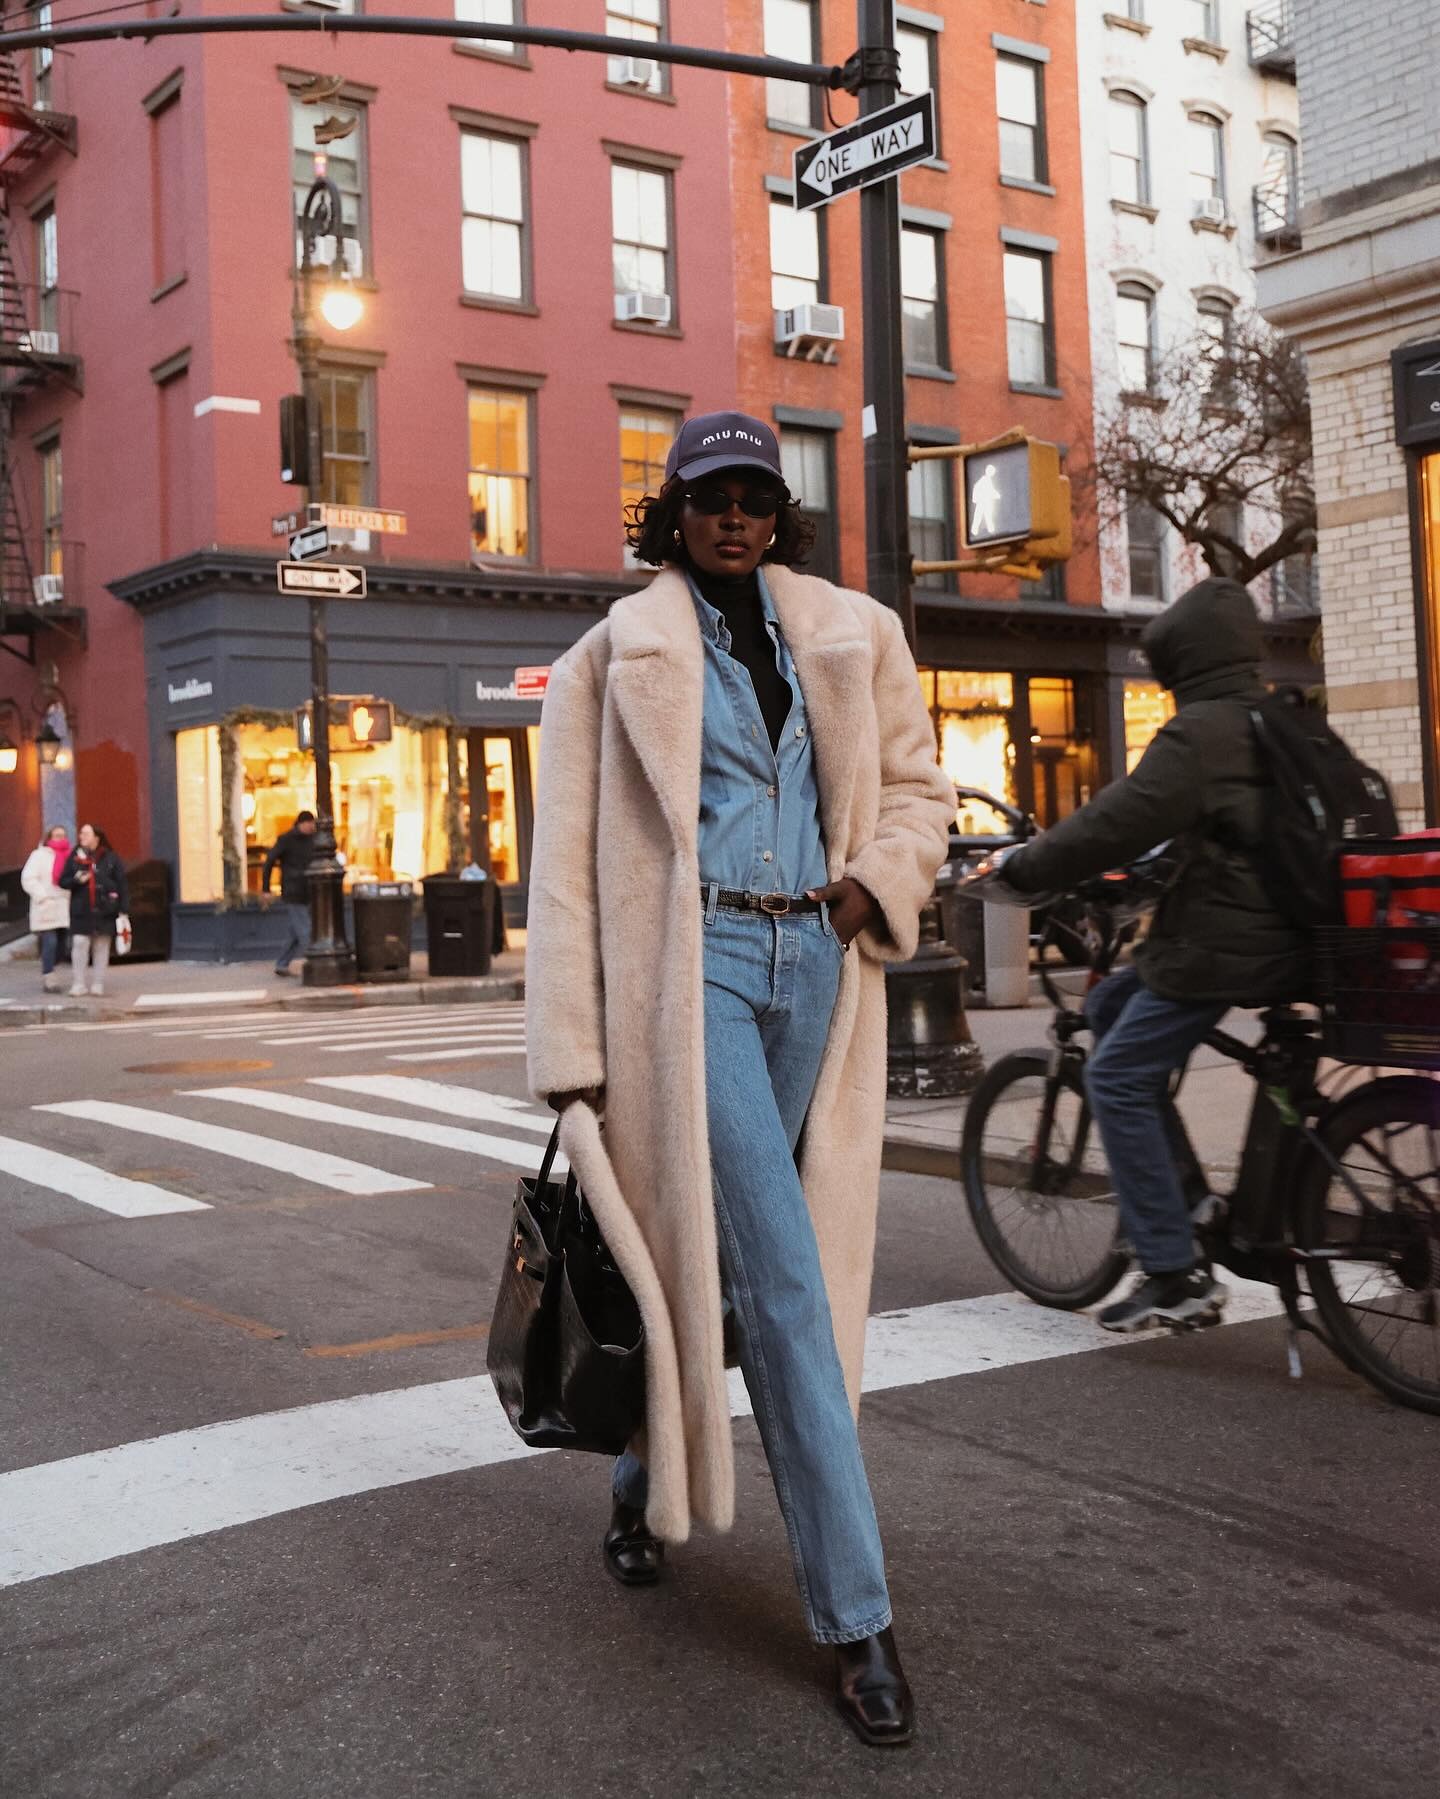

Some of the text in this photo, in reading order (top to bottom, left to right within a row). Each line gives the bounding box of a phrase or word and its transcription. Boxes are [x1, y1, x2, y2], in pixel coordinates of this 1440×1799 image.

[815, 119, 913, 183] ONE WAY
[702, 429, 762, 446] miu miu
